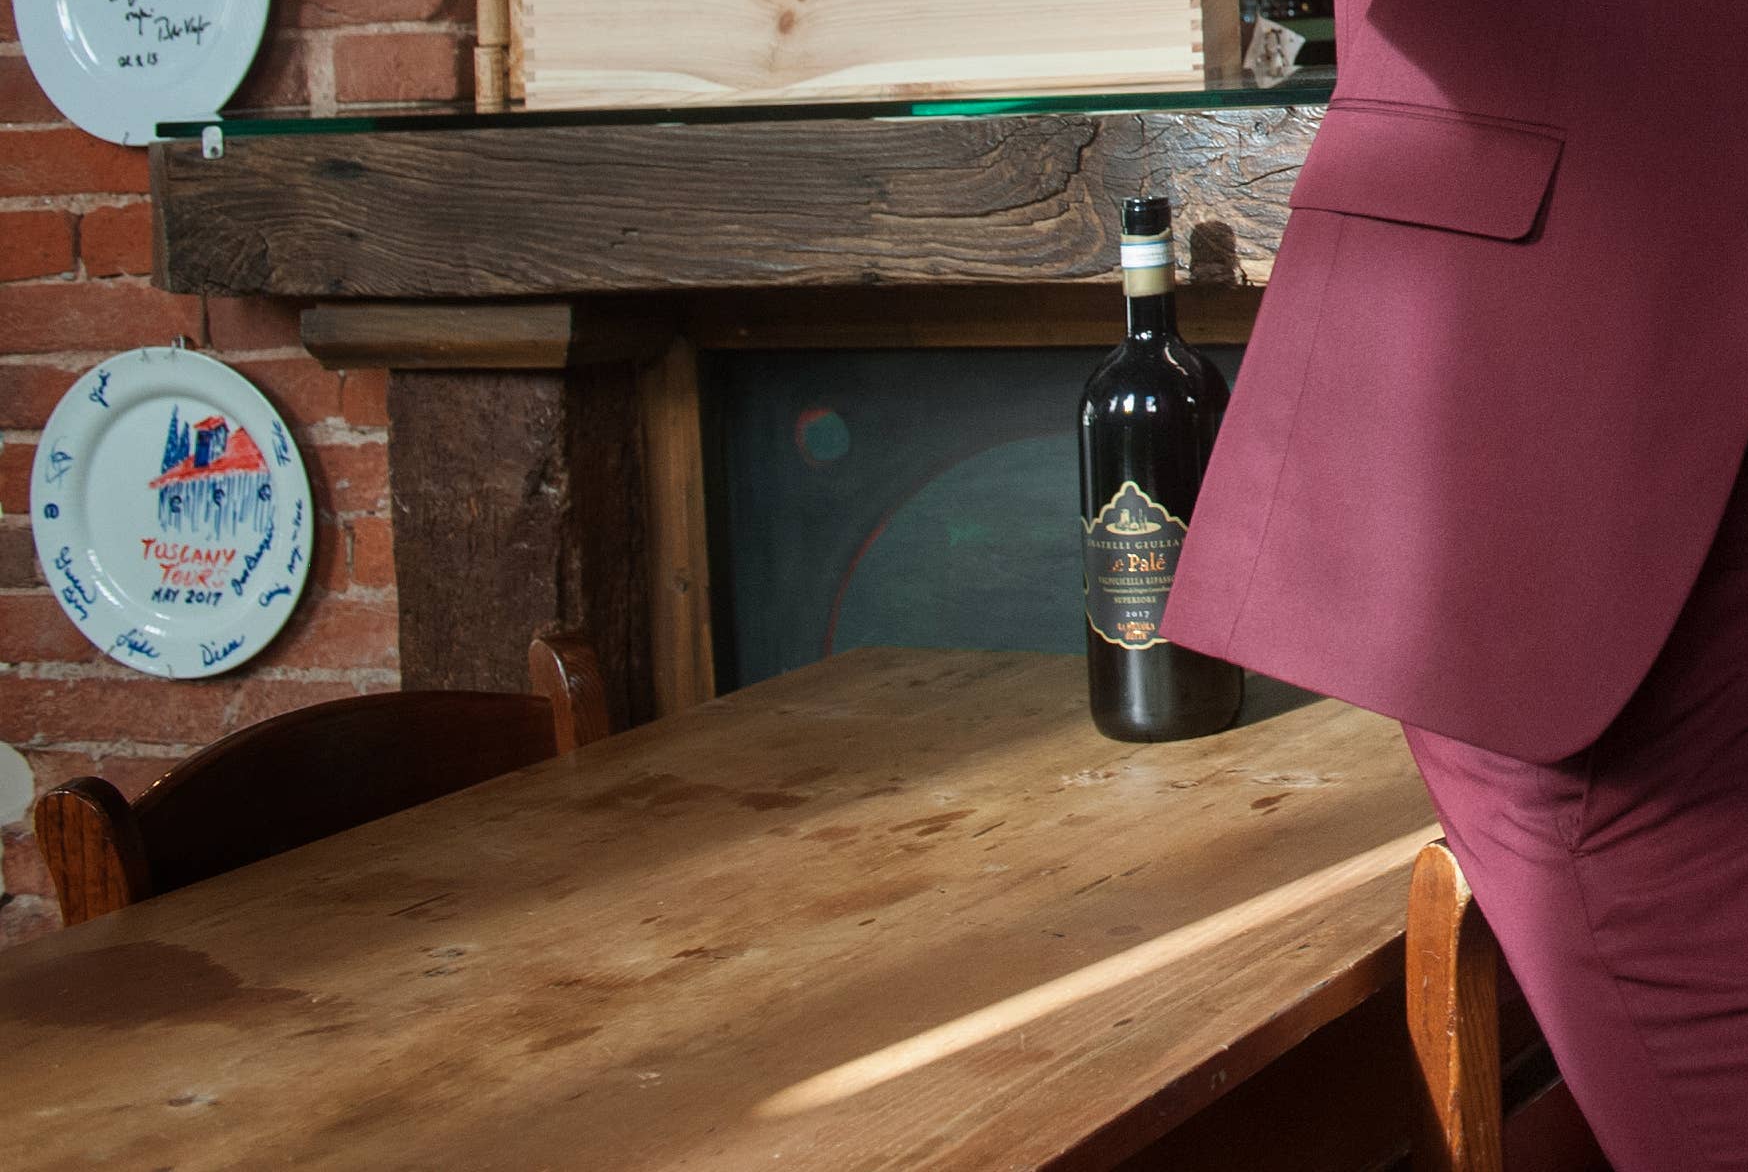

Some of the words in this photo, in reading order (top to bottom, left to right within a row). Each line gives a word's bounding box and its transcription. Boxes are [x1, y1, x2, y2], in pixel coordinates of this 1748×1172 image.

[141, 536, 238, 567] TUSCANY
[1134, 539, 1184, 550] GIULIA
[1127, 551, 1167, 572] Palé
[1125, 609, 1150, 618] 2017
